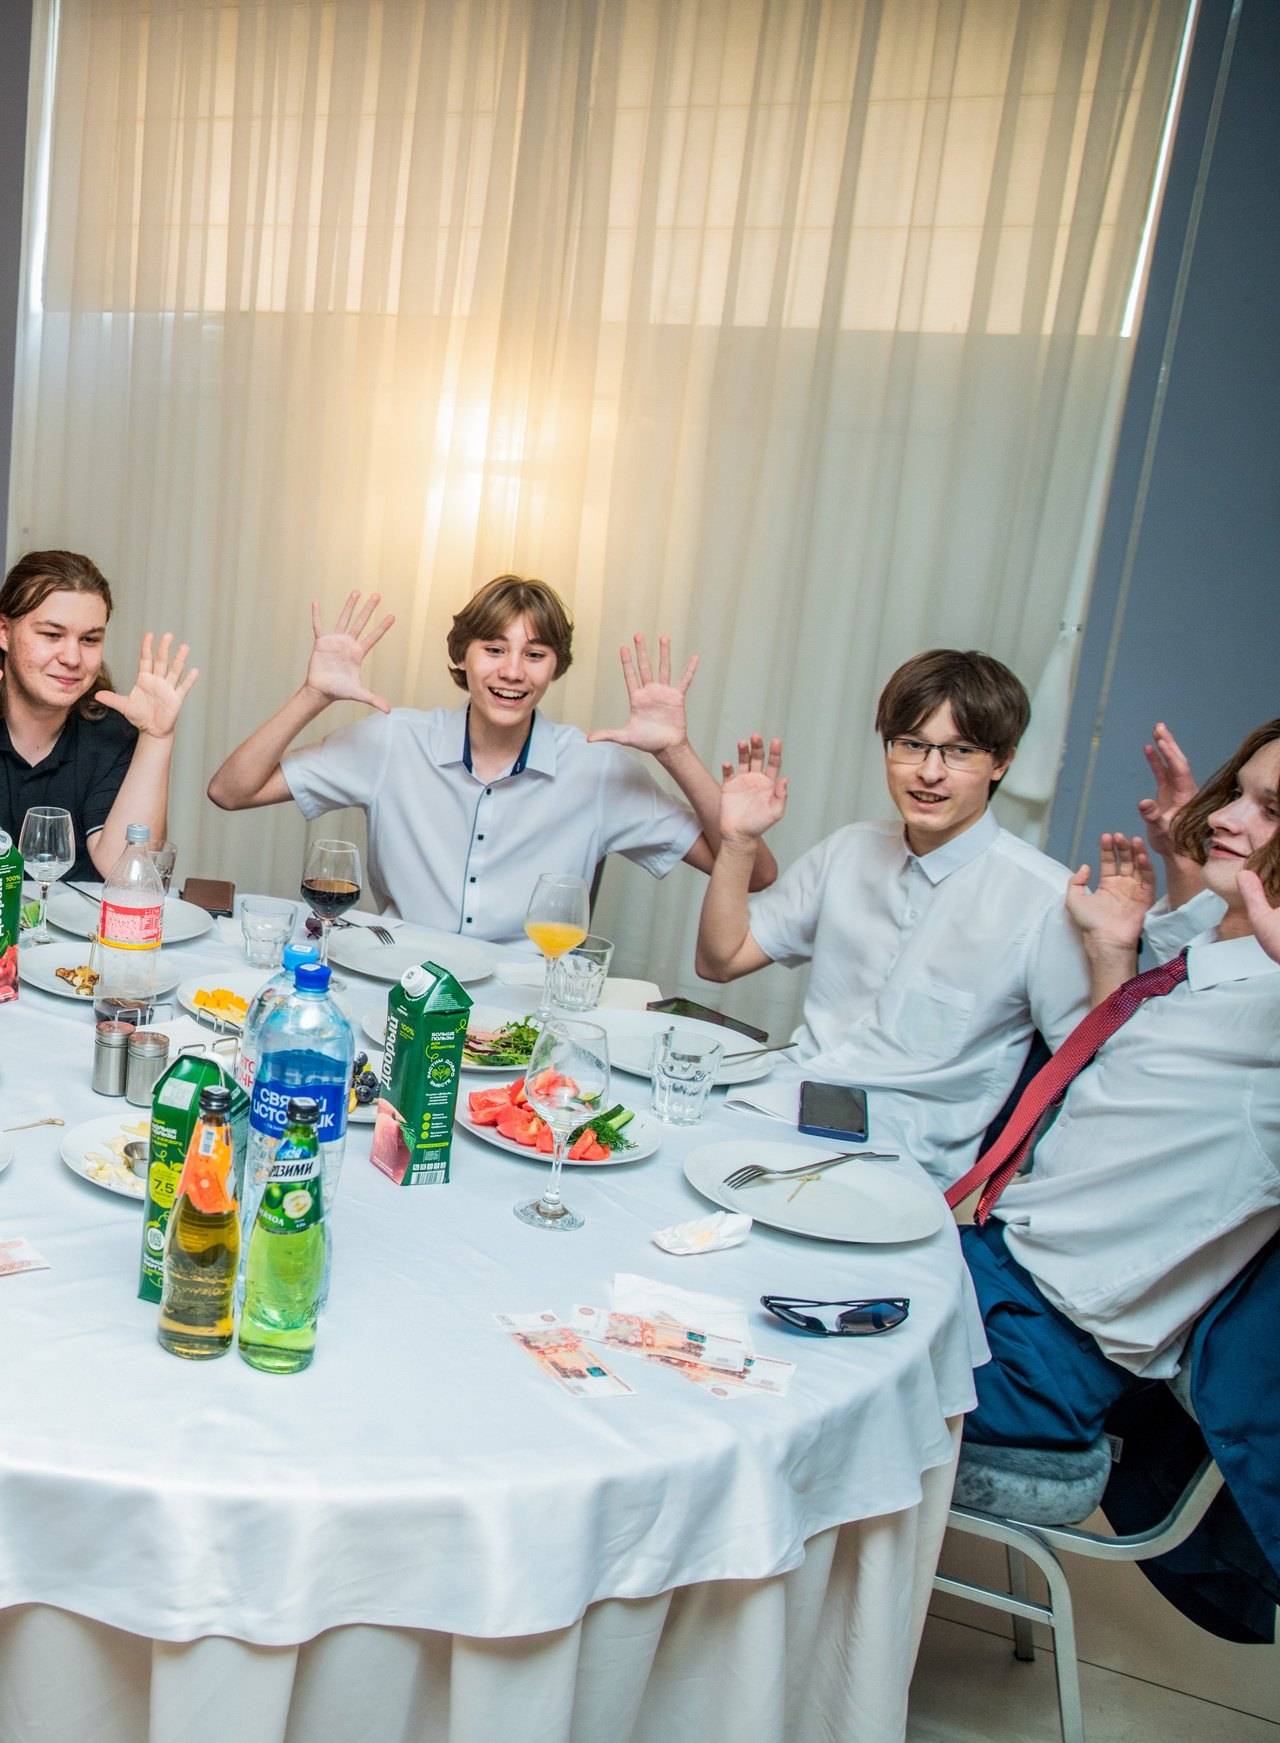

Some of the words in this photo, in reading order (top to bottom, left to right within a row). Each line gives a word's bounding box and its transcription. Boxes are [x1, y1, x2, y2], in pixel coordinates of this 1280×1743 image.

[401, 1022, 415, 1036] 100%
[427, 1058, 444, 1079] РАСТИМ
[445, 1059, 456, 1077] ДОБРО
[260, 1088, 327, 1112] СВЯЙ
[253, 1098, 335, 1128] ИСТОИК
[269, 1161, 314, 1177] РДЗИМИ
[154, 1178, 174, 1194] 7.5
